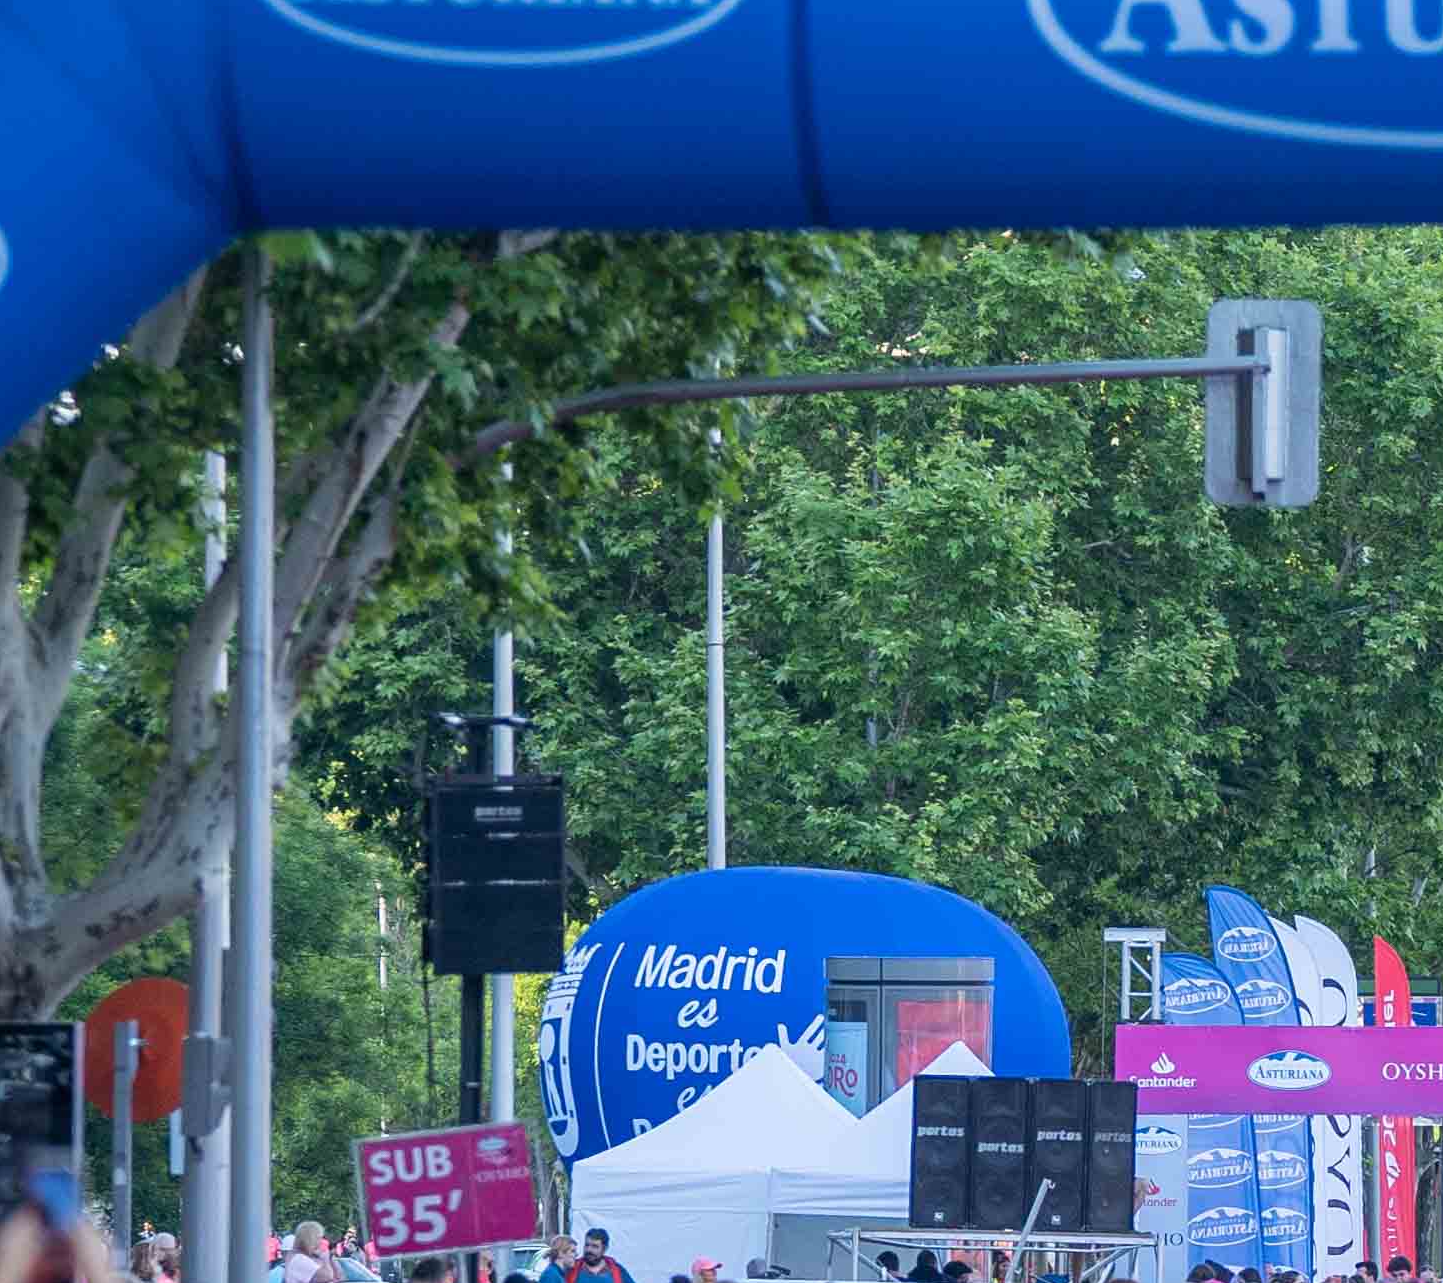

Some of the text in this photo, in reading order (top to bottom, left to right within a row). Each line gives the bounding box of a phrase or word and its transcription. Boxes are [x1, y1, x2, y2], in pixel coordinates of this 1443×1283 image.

[633, 944, 787, 994] Madrid
[676, 997, 719, 1028] es
[1254, 1064, 1325, 1081] ASTURIANA
[368, 1144, 453, 1187] SUB
